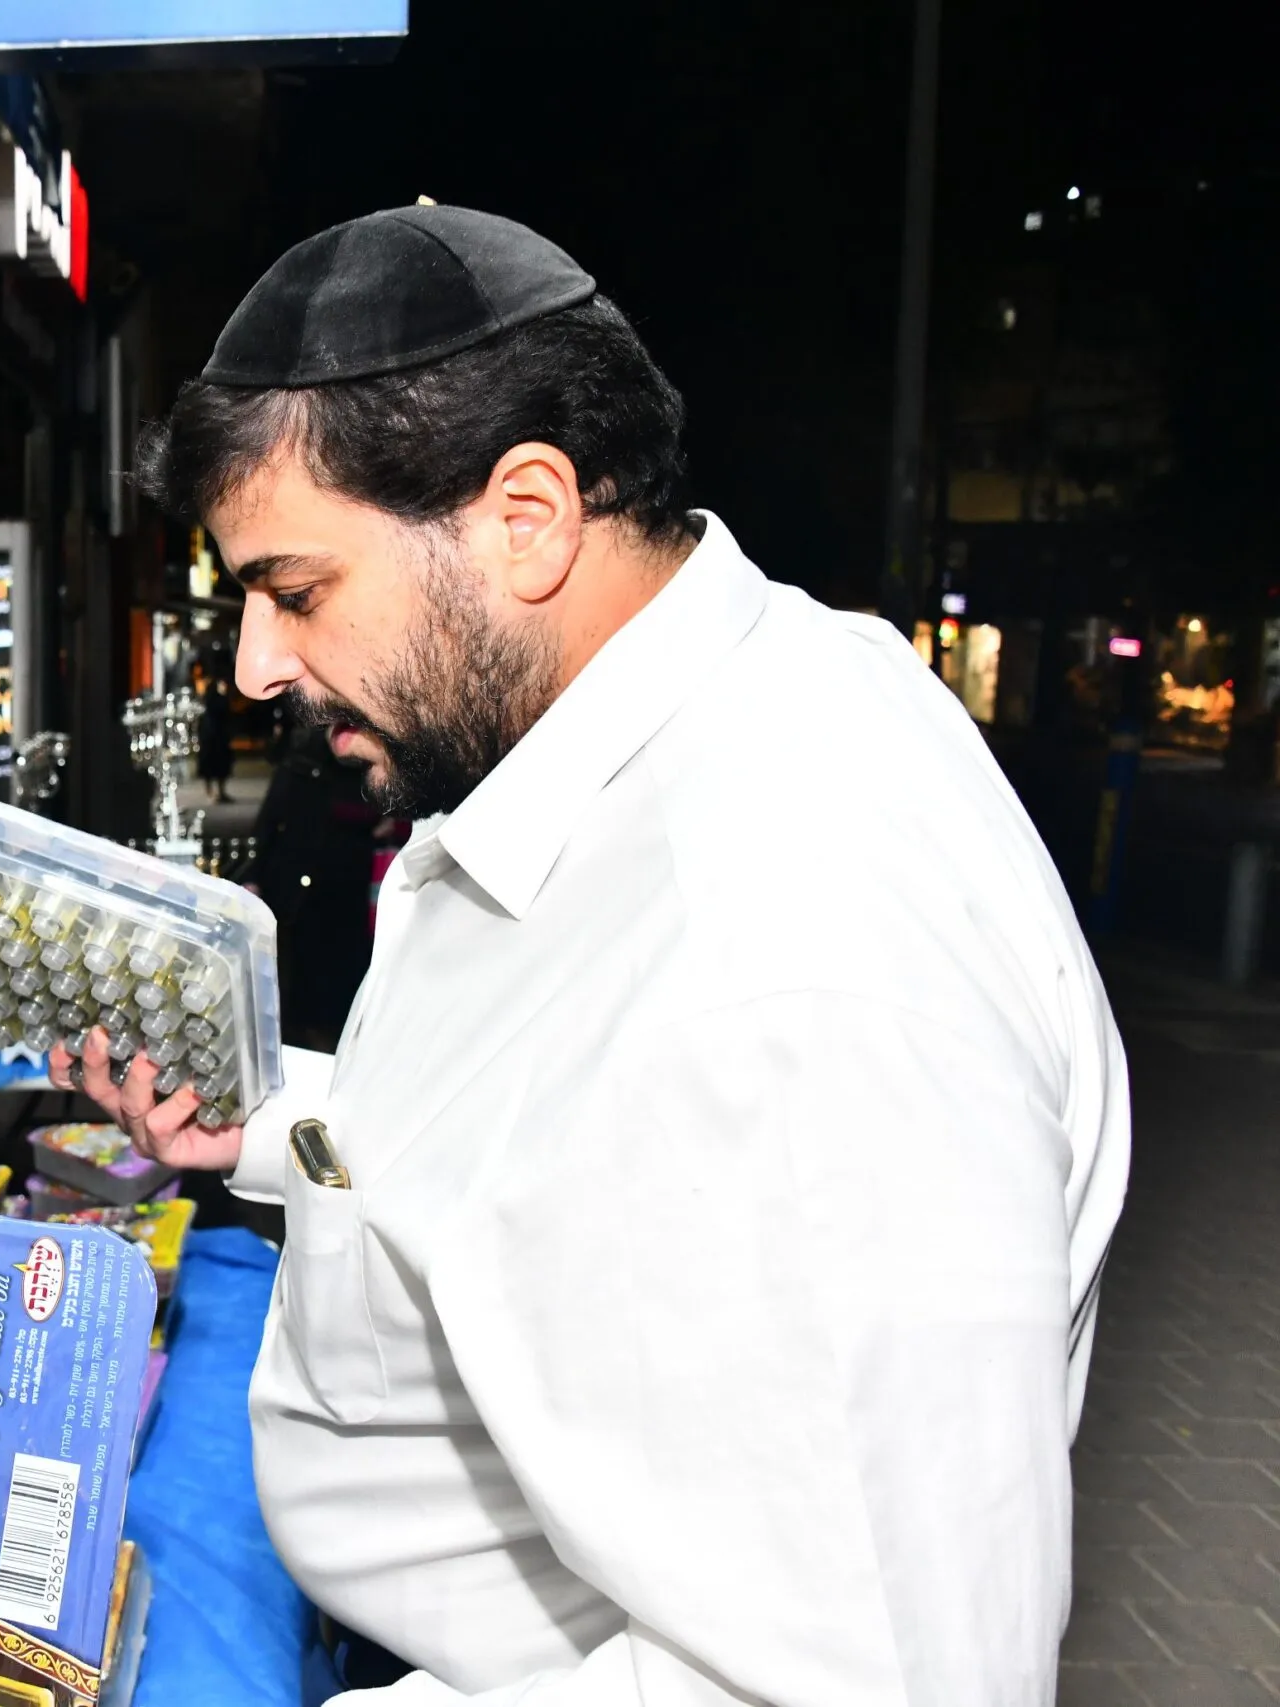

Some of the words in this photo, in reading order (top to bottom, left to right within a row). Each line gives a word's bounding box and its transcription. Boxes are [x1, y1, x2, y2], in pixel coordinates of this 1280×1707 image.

[79, 1318, 87, 1331] אש
[98, 1390, 113, 1428] בישראל
[92, 1444, 106, 1471] מפעל
[90, 1475, 101, 1501] שומר
[56, 1482, 74, 1539] 678558
[86, 1505, 97, 1530] שבת
[46, 1548, 65, 1601] 925621
[43, 1614, 55, 1623] 6
